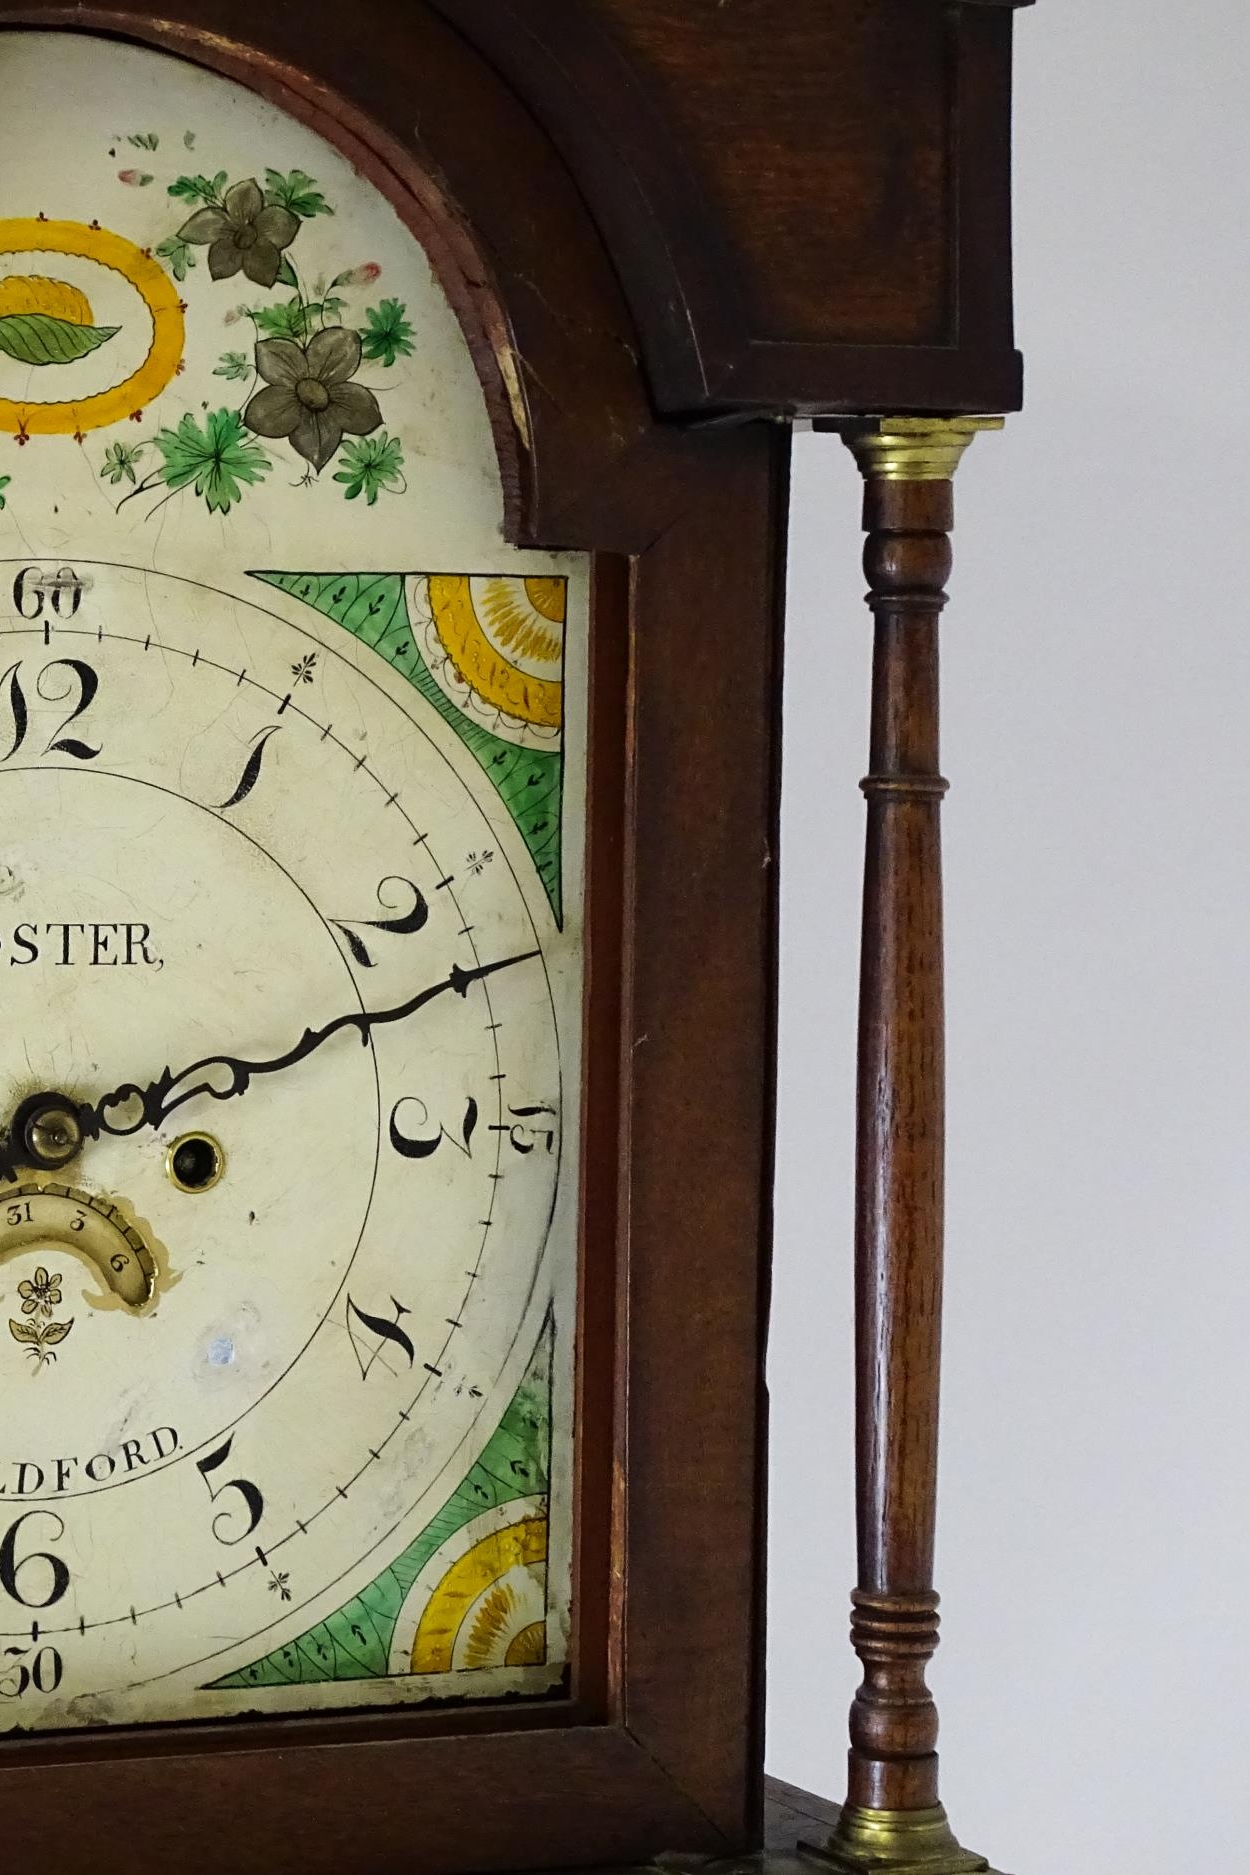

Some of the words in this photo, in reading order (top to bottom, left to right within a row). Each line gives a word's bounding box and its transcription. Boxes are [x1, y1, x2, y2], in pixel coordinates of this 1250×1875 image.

[13, 566, 82, 620] 60
[210, 725, 283, 809] 1
[327, 875, 428, 967] 2
[389, 1096, 477, 1160] 3
[507, 1103, 556, 1155] 15
[7, 1202, 34, 1226] 31
[69, 1209, 87, 1232] 3
[346, 1292, 414, 1381] 4
[196, 1430, 263, 1546] 5
